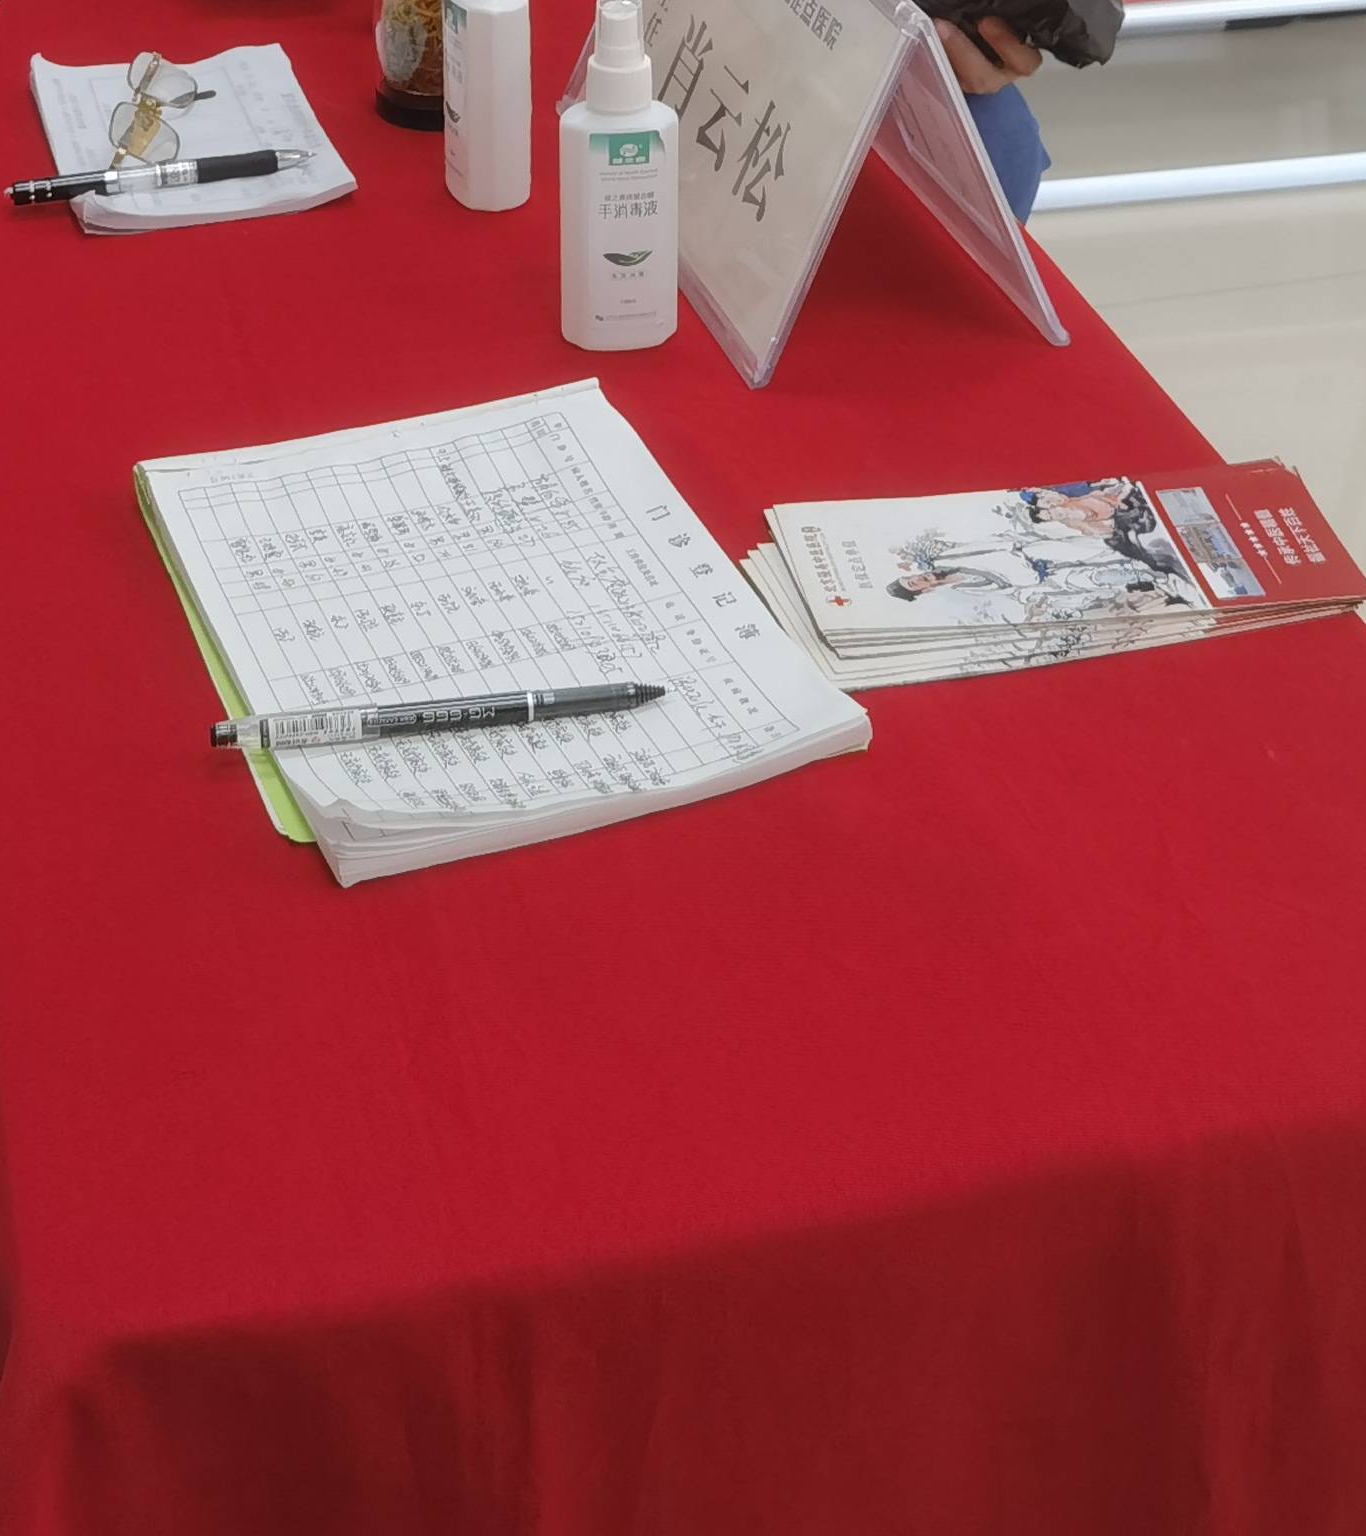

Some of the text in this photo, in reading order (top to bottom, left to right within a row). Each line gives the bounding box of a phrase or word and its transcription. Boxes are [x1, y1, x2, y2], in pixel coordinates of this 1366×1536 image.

[659, 13, 792, 223] 肖云松
[597, 200, 659, 220] 手消毒液
